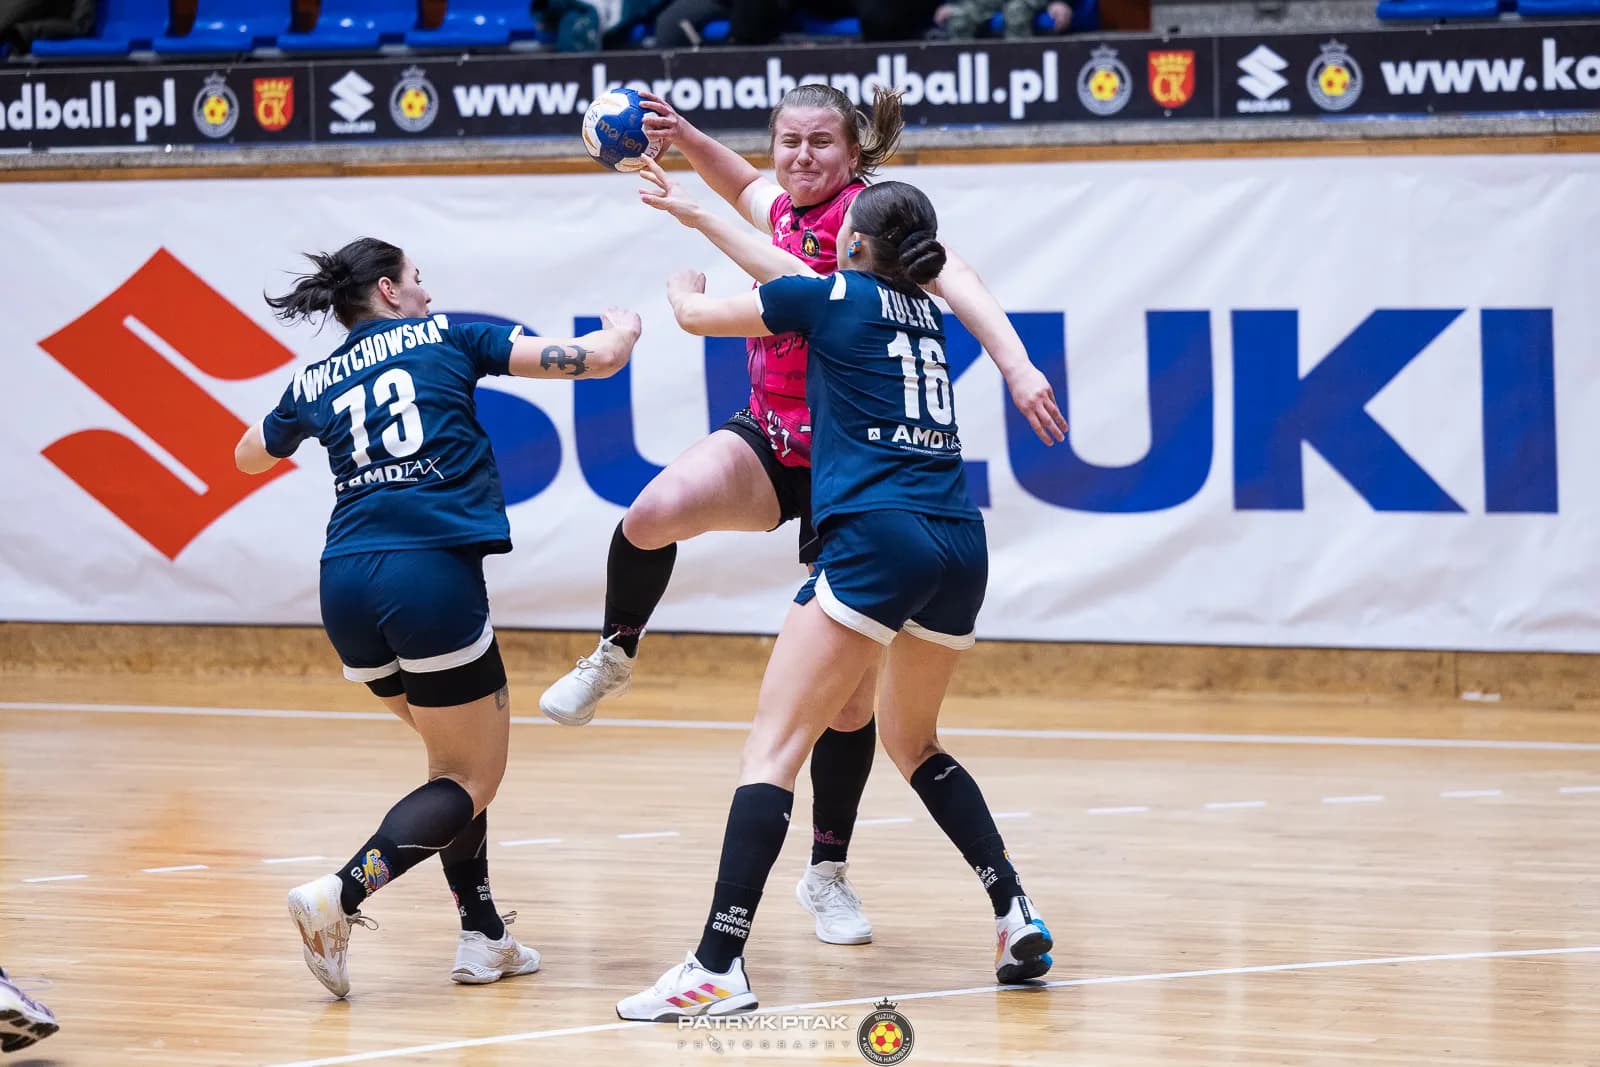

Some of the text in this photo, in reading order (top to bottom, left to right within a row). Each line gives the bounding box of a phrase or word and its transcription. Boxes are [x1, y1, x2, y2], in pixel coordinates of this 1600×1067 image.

[1380, 38, 1600, 95] www.ko
[0, 79, 176, 142] dball.pl
[876, 285, 939, 331] KULIK
[887, 330, 953, 426] 16
[331, 368, 424, 468] 73
[712, 921, 749, 939] GLIWICE
[729, 905, 748, 917] SPR
